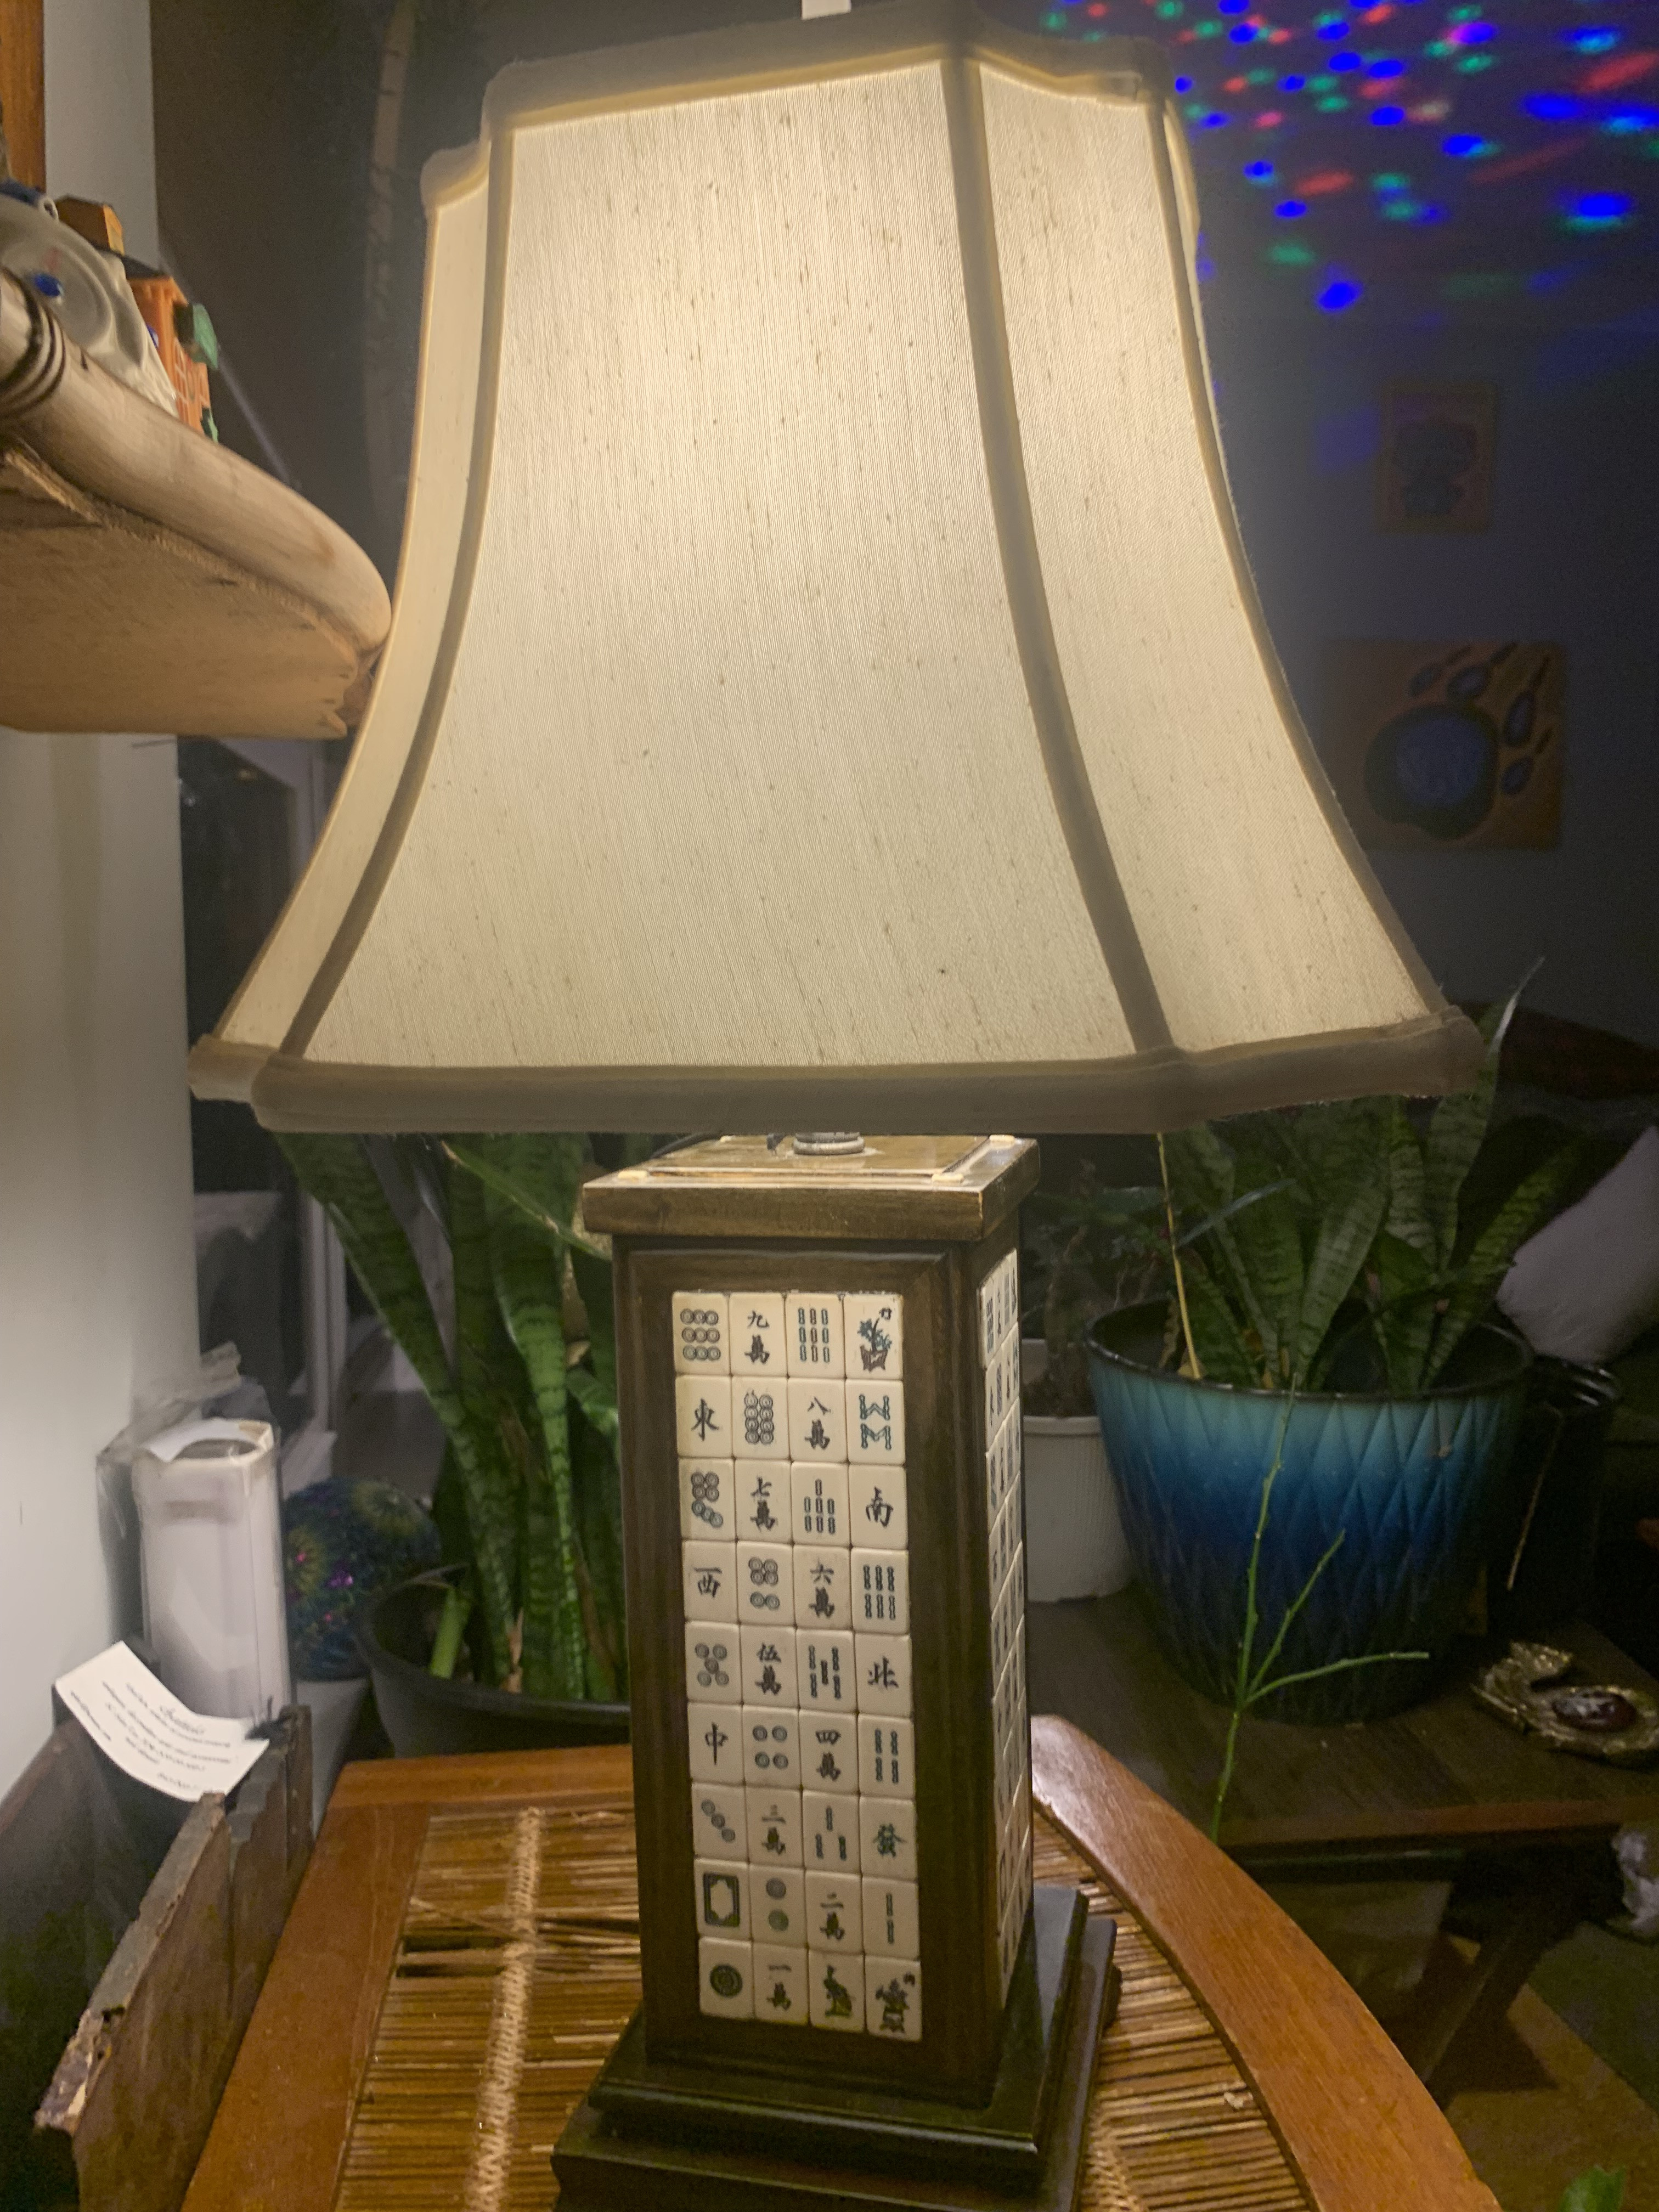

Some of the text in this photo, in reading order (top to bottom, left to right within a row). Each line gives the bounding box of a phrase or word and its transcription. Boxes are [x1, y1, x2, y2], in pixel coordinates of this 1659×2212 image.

[744, 1310, 770, 1364] 九萬
[691, 1398, 720, 1442] 東
[805, 1397, 831, 1450] 八萬
[749, 1477, 777, 1531] 七萬
[865, 1487, 894, 1528] 南
[693, 1567, 723, 1599] 西
[809, 1562, 835, 1619] 六萬
[867, 1656, 899, 1690] 北
[704, 1722, 729, 1765] 中
[815, 1729, 842, 1782] 四萬
